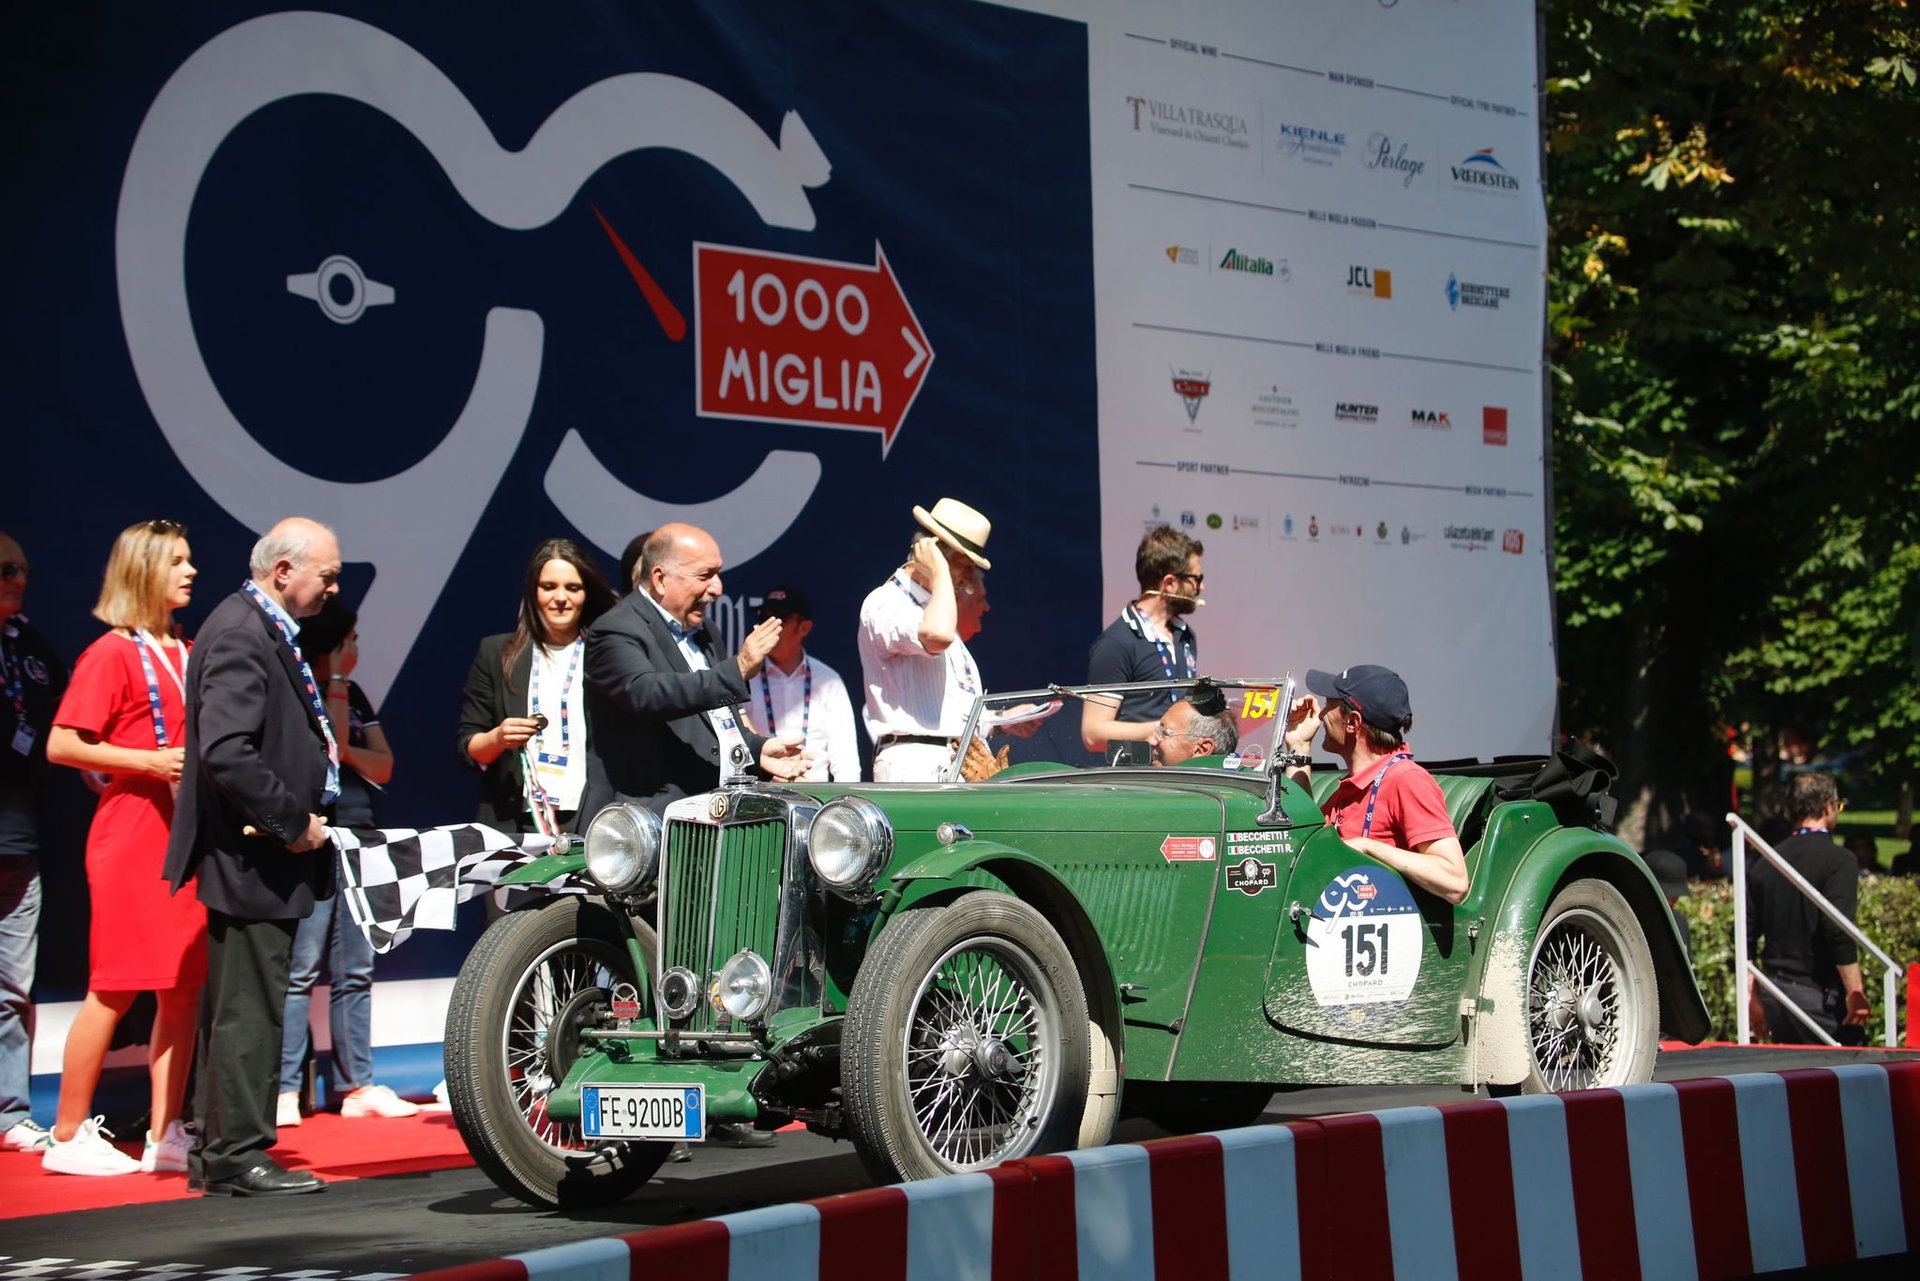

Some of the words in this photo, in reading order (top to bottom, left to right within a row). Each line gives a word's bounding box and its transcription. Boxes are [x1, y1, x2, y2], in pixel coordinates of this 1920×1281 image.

[1346, 74, 1375, 89] SPONSOR
[1149, 100, 1187, 124] VILLA
[1188, 107, 1248, 136] TRASQUA
[1280, 123, 1345, 145] KIENLE
[1361, 131, 1426, 190] Perlage
[1451, 166, 1520, 191] VREDESTEIN
[1328, 213, 1350, 225] MIGLIA
[1351, 216, 1377, 230] PASSION
[1220, 248, 1274, 276] Alitalia
[1347, 264, 1373, 289] JCL
[727, 268, 869, 336] 1000
[1315, 342, 1335, 355] MILLE
[1335, 345, 1357, 358] MIGLIA
[1358, 347, 1381, 360] FRIEND
[718, 346, 882, 414] MIGLIA
[1336, 402, 1379, 416] HUNTER
[1411, 410, 1450, 425] MAK
[1177, 461, 1199, 473] SPORT
[1200, 464, 1230, 476] PARTNER
[1338, 474, 1371, 487] PATROCINI
[1465, 485, 1482, 496] MEDIA
[1483, 487, 1507, 498] PARTNER
[1241, 689, 1280, 719] 151
[1238, 831, 1283, 842] BECCHETTI
[1283, 830, 1292, 841] F.
[1239, 844, 1284, 855] BECCHETTI
[1284, 843, 1293, 854] R.
[1234, 878, 1269, 887] CHOPARD
[1341, 923, 1389, 977] 151
[1348, 979, 1383, 988] CHOPARD
[600, 1096, 621, 1127] FE
[627, 1097, 684, 1128] 920DB
